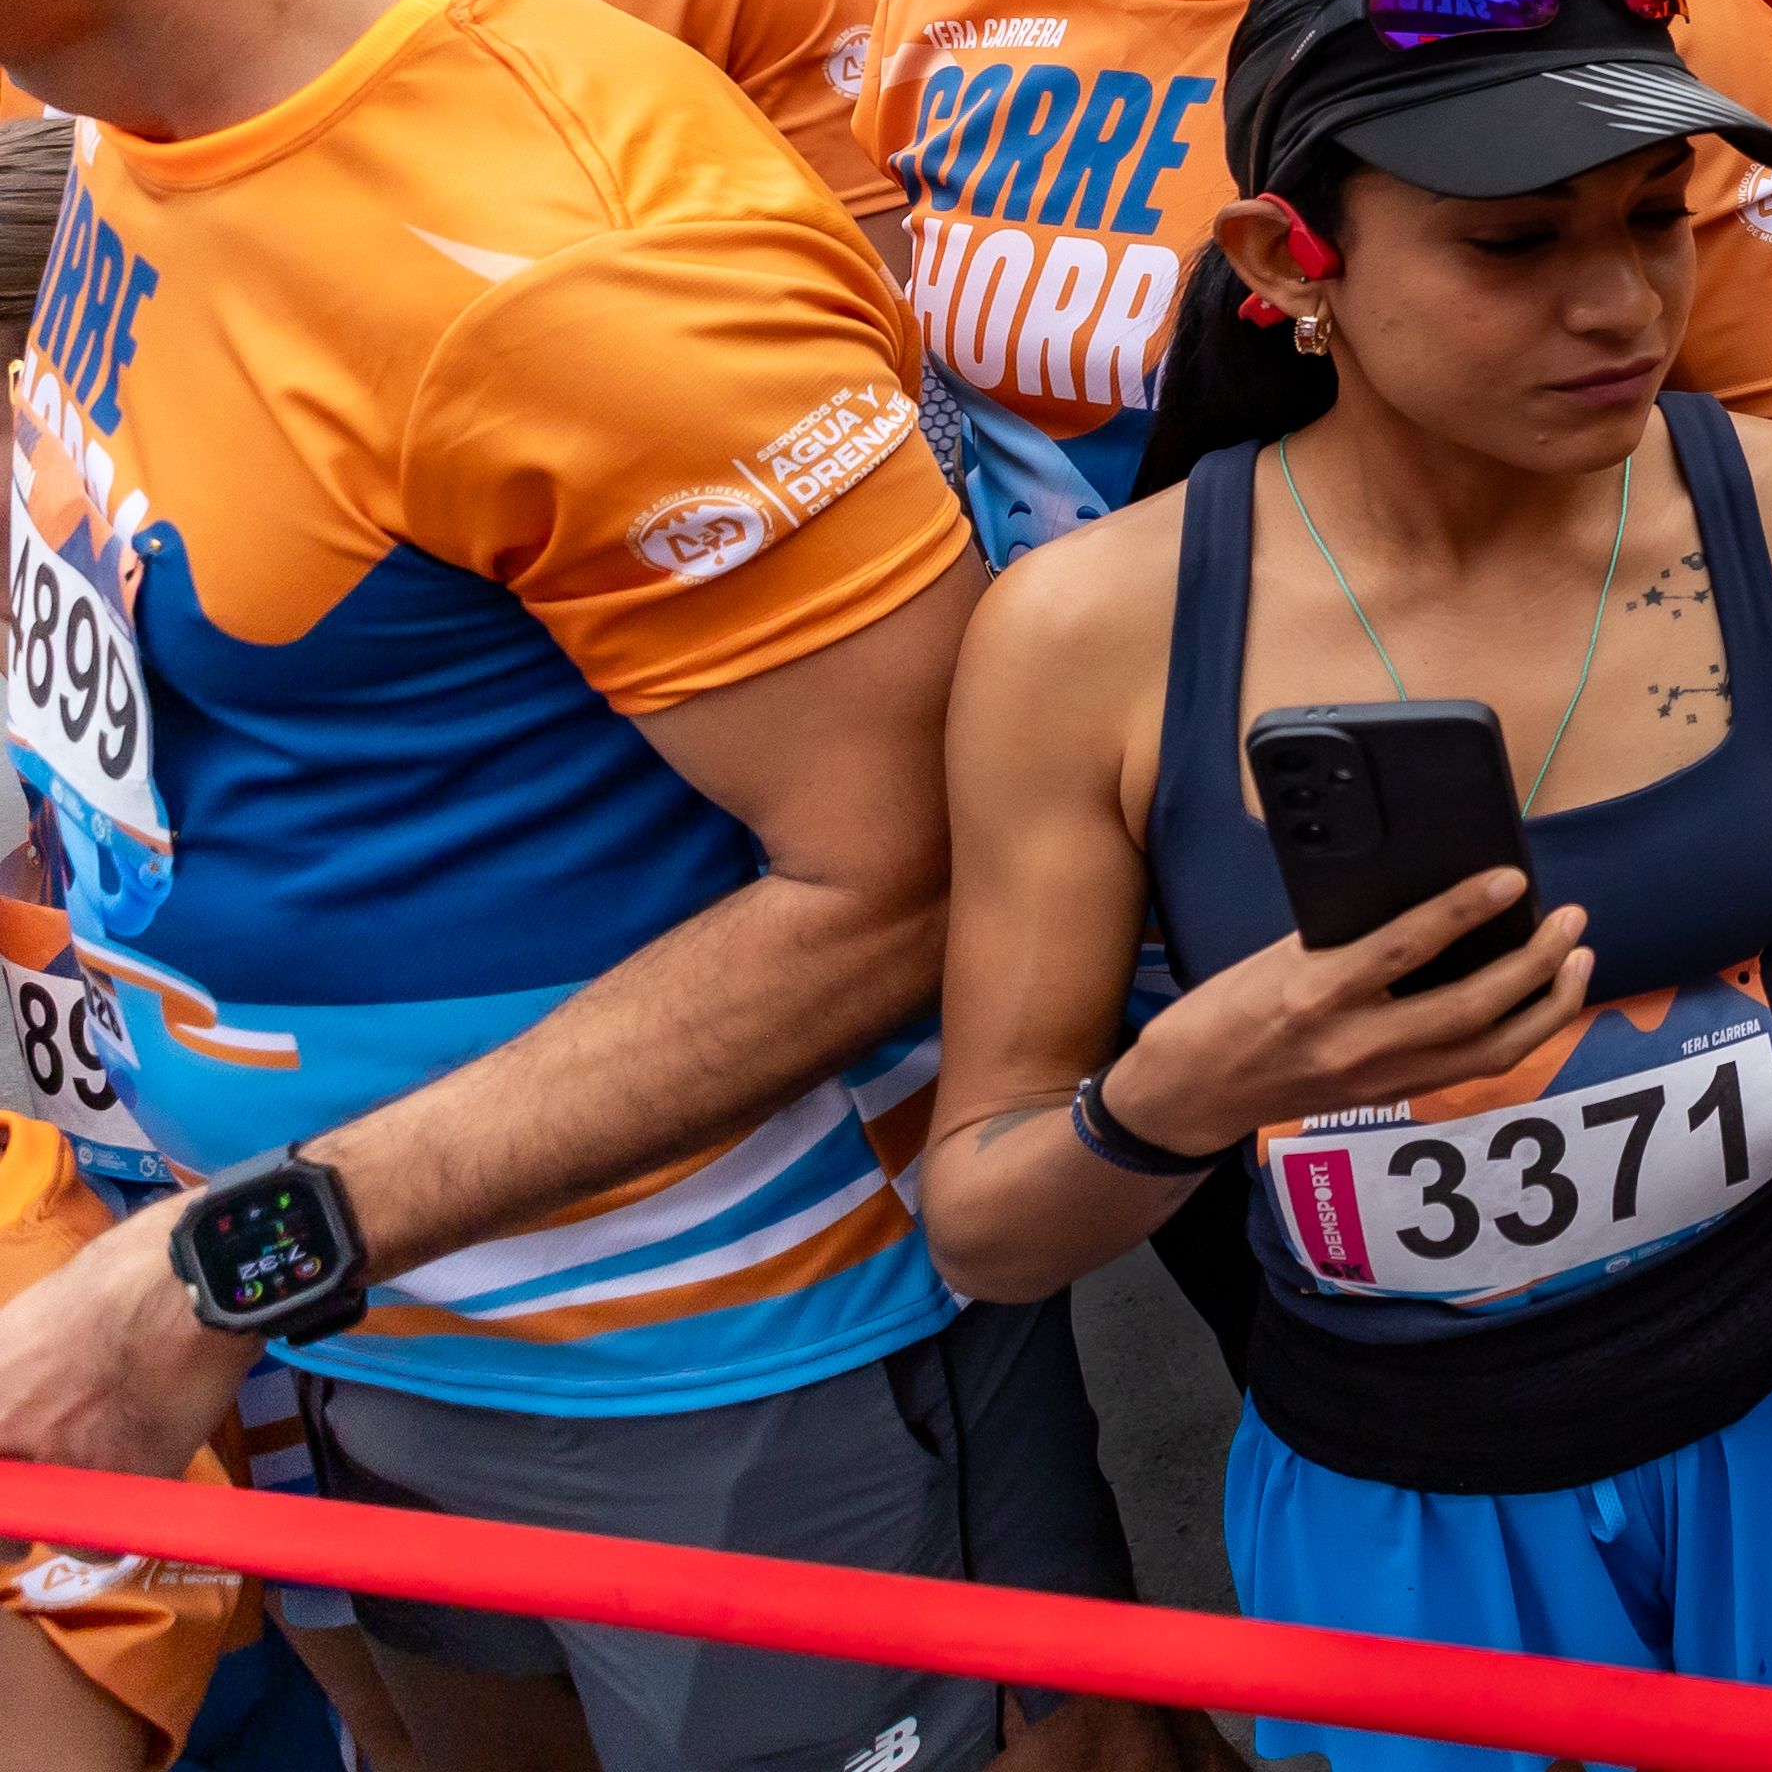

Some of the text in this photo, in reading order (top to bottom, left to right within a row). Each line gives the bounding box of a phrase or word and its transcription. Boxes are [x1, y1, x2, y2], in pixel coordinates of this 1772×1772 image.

[922, 17, 1068, 50] 1ERA CARRERA
[886, 63, 1217, 237] CORRE
[901, 212, 1181, 412] HORR
[756, 387, 853, 462] SERVICIOS DE
[770, 383, 881, 483] AGUA Y
[786, 390, 913, 506] DRENAJE
[1680, 1017, 1761, 1057] 1ERA CARRERA
[1387, 1060, 1750, 1260] 3371
